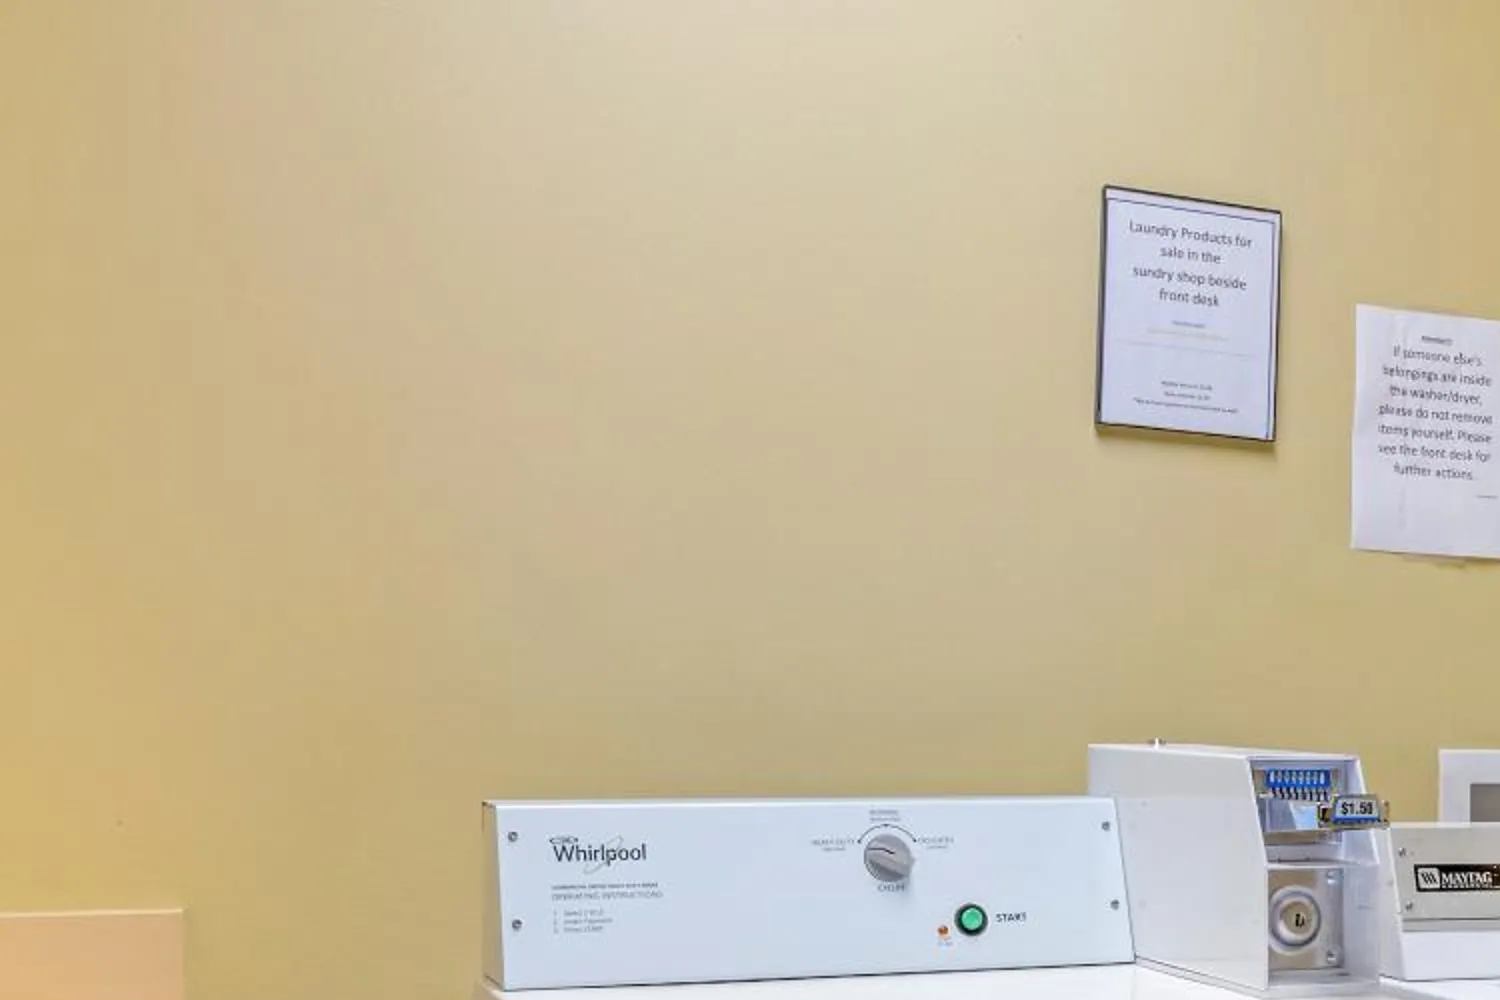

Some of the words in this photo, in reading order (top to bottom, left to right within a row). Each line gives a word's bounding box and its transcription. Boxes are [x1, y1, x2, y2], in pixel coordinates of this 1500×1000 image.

[1129, 219, 1178, 240] Laundry
[1181, 227, 1232, 246] Products
[1235, 234, 1253, 248] for
[1160, 246, 1184, 259] sale
[1188, 248, 1198, 260] in
[1202, 251, 1221, 264] the
[1133, 266, 1174, 282] sundry
[1177, 271, 1205, 286] shop
[1208, 273, 1247, 291] beside
[1159, 287, 1189, 303] front
[1192, 293, 1219, 307] desk
[1393, 344, 1400, 357] If
[1403, 349, 1450, 361] someone
[1383, 364, 1438, 382] belongings
[1440, 373, 1457, 382] are
[1460, 374, 1493, 387] inside
[1389, 384, 1408, 397] the
[1379, 403, 1412, 417] please
[1416, 407, 1428, 419] do
[1432, 410, 1449, 420] not
[1451, 412, 1493, 425] remove
[1378, 424, 1408, 436] items
[1457, 429, 1492, 443] Please
[1378, 445, 1397, 456] see
[1400, 443, 1419, 457] the
[1421, 446, 1447, 459] front
[1450, 448, 1473, 461] desk
[1475, 449, 1491, 463] for
[1393, 462, 1431, 477] further
[1341, 801, 1373, 816] $1.50
[553, 842, 647, 867] Whirlpool
[1441, 871, 1494, 885] MAYTAG
[995, 911, 1026, 923] START
